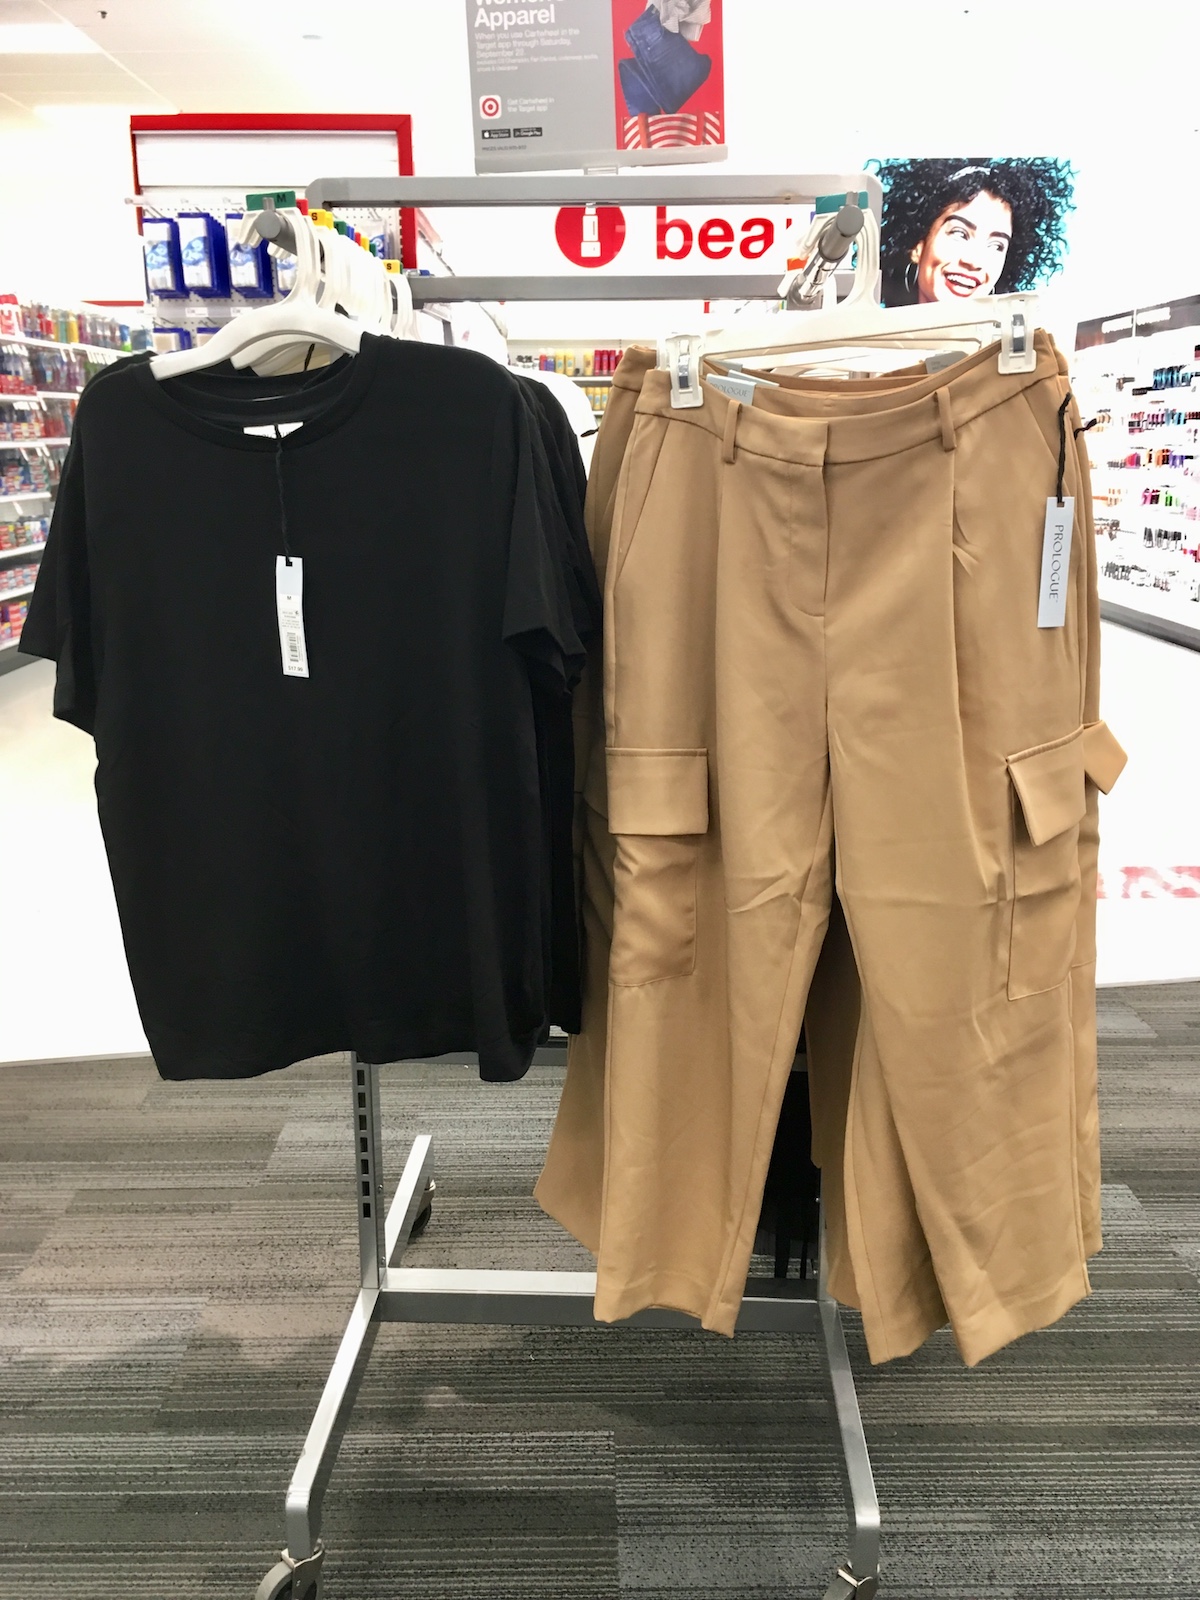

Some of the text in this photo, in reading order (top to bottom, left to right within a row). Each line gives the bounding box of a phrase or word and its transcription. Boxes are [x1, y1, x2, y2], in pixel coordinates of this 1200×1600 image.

[474, 4, 556, 30] Apparel
[474, 32, 496, 40] When
[497, 32, 510, 41] you
[476, 42, 497, 50] Target
[498, 41, 511, 49] app
[512, 39, 539, 48] through
[476, 50, 514, 59] September
[276, 193, 286, 203] M
[311, 212, 318, 221] S
[656, 205, 792, 260] bea
[386, 262, 392, 271] S
[1049, 524, 1064, 599] PROLOGUE
